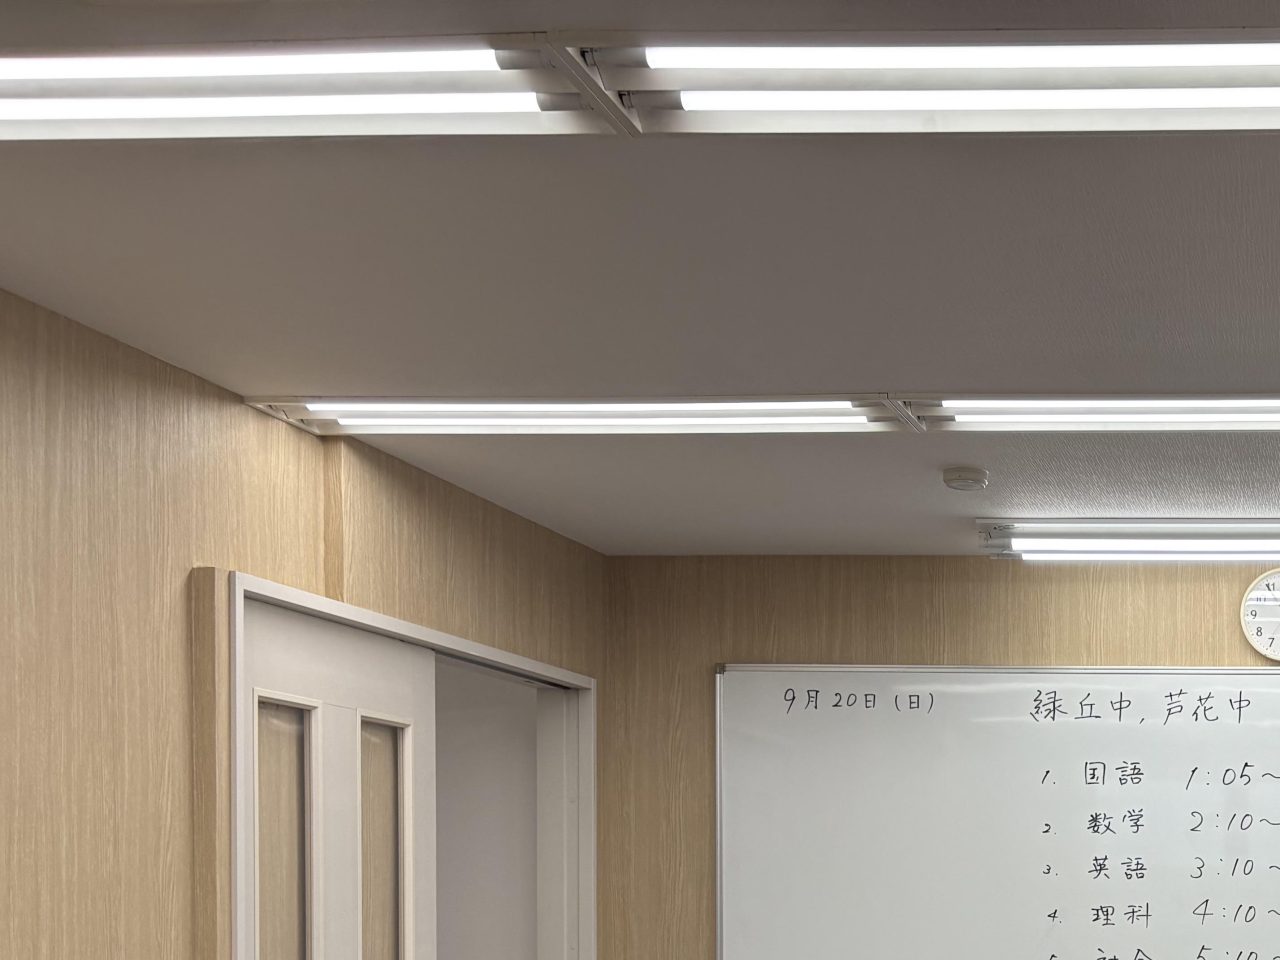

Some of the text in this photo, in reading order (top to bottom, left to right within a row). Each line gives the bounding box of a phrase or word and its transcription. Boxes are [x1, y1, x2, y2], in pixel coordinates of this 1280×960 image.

[1250, 609, 1257, 619] 9
[1256, 626, 1263, 637] 8
[1268, 637, 1275, 647] 7
[1084, 760, 1145, 786] 国語
[1086, 808, 1145, 836] 数学
[1087, 854, 1148, 881] 英語
[1090, 901, 1153, 929] 理科
